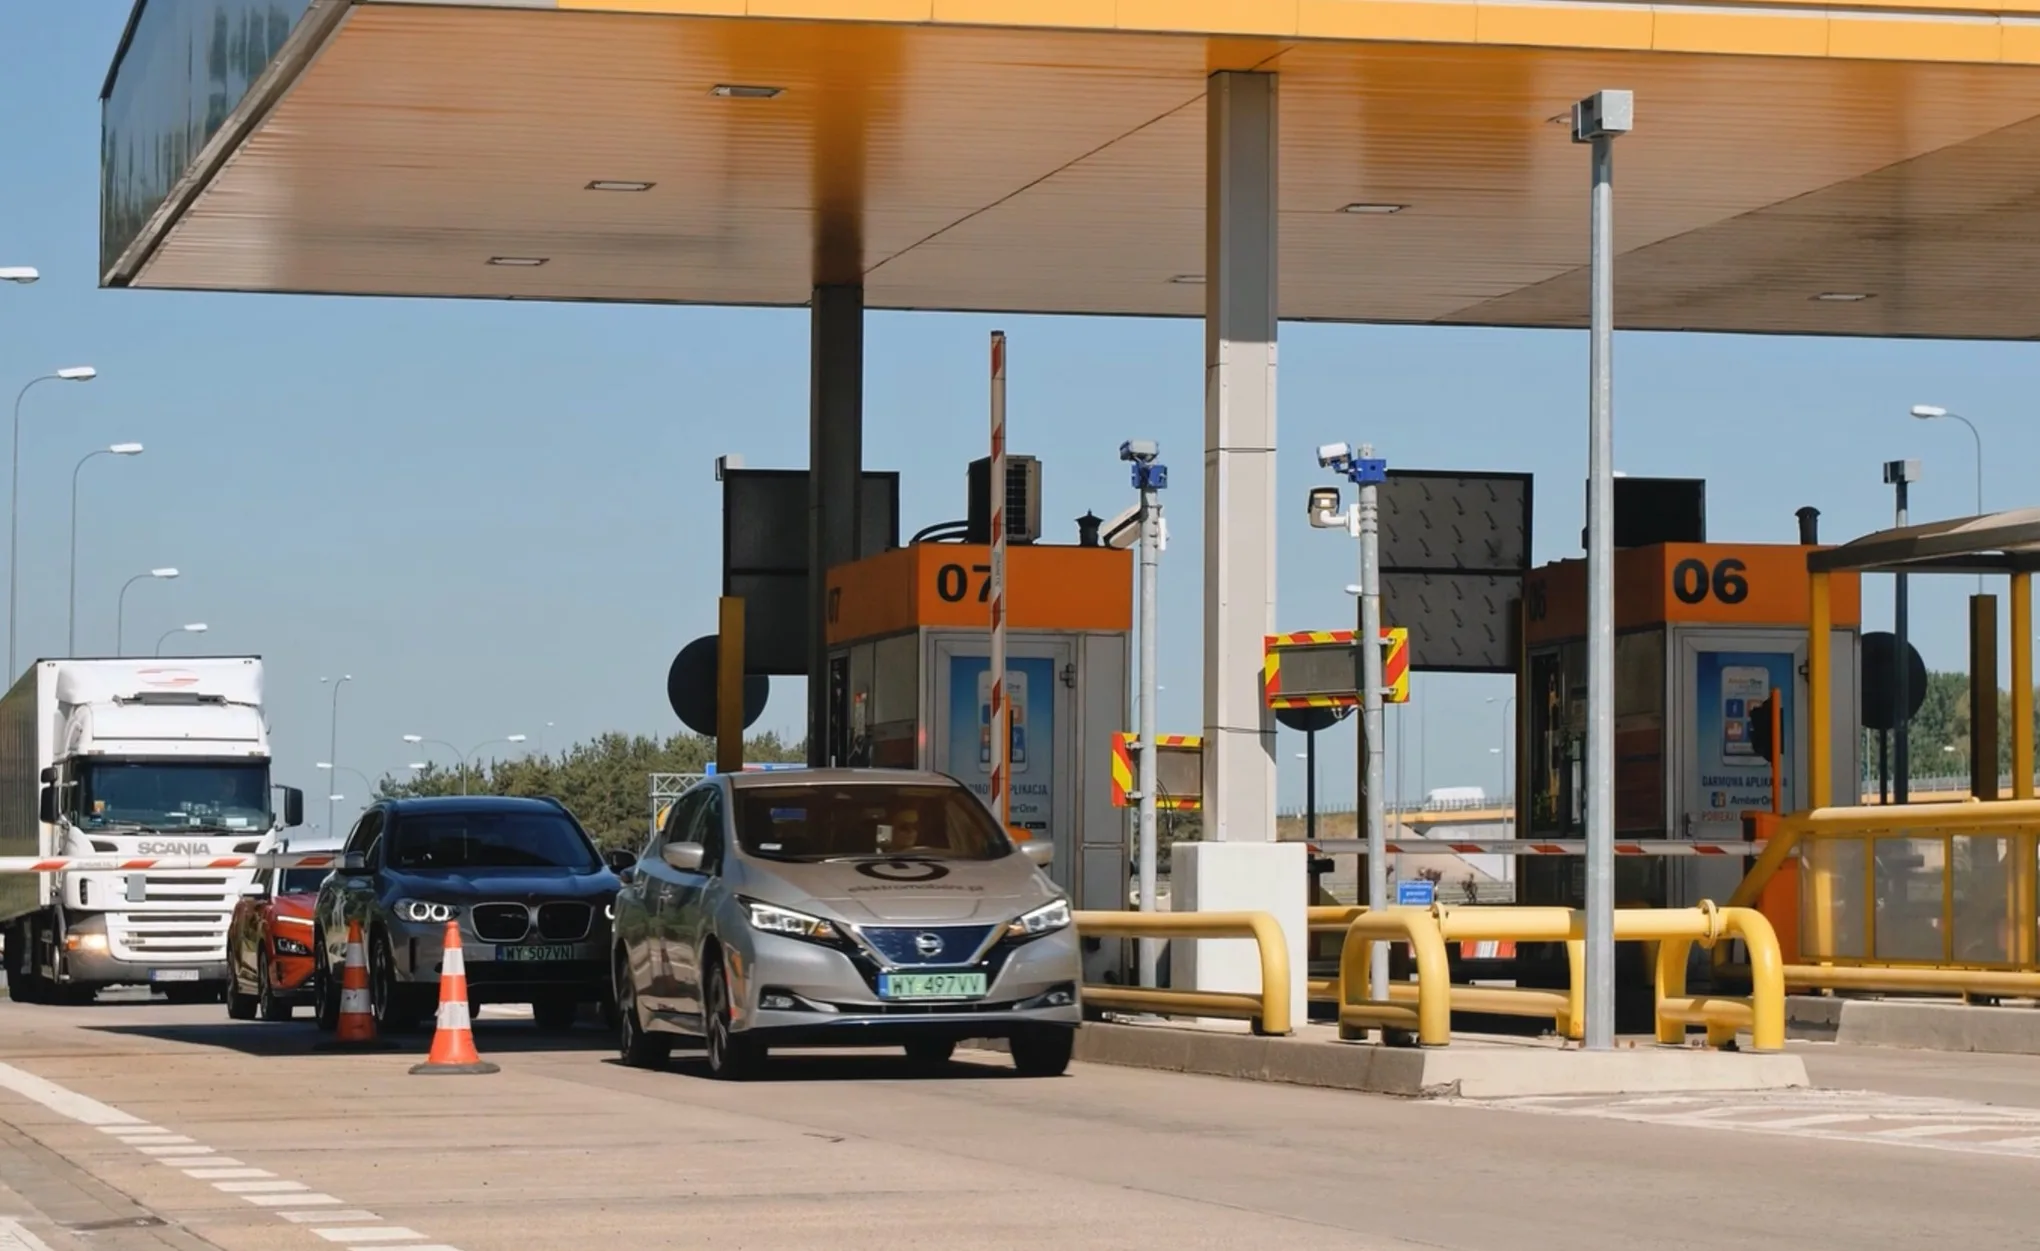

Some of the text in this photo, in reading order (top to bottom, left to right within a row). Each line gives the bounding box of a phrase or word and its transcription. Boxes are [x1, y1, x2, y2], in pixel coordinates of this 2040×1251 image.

[937, 563, 992, 603] 07
[1673, 558, 1749, 604] 06
[137, 841, 211, 855] SCANIA
[892, 975, 980, 995] WY 497VV
